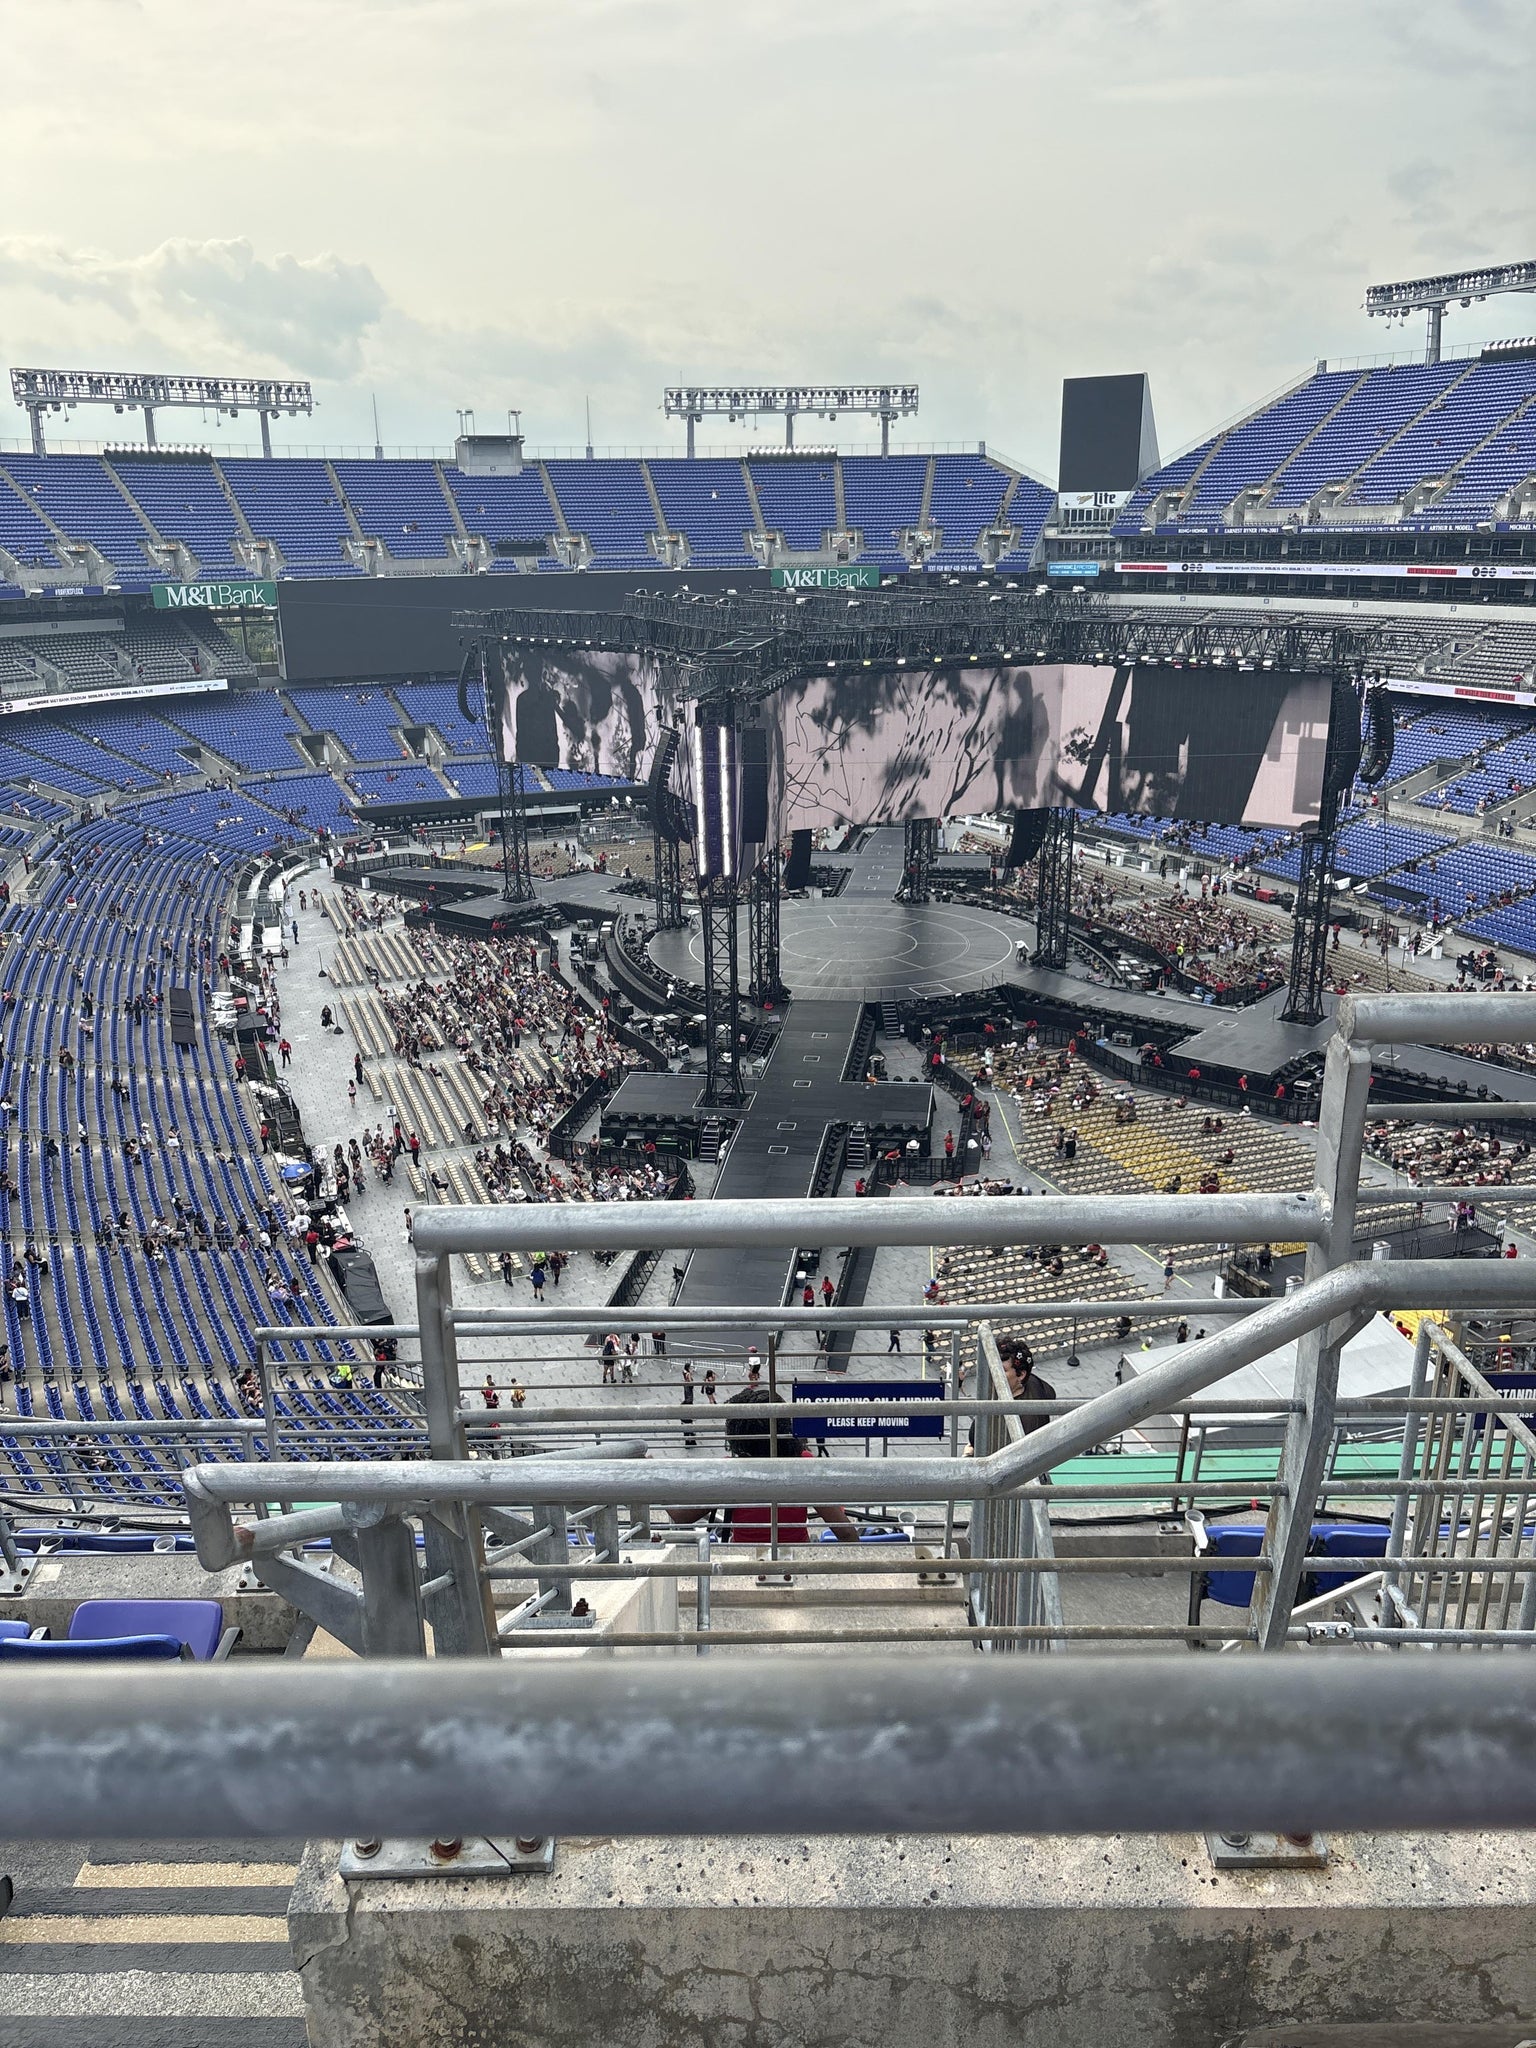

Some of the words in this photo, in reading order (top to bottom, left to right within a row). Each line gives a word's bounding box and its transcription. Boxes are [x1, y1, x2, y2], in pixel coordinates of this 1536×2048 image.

[1093, 492, 1116, 507] Lite
[782, 569, 826, 587] M&T
[827, 568, 869, 587] Bank
[165, 585, 216, 607] M&T
[218, 584, 266, 605] Bank
[827, 1417, 855, 1427] PLEASE
[857, 1417, 876, 1427] KEEP
[878, 1417, 909, 1427] MOVING
